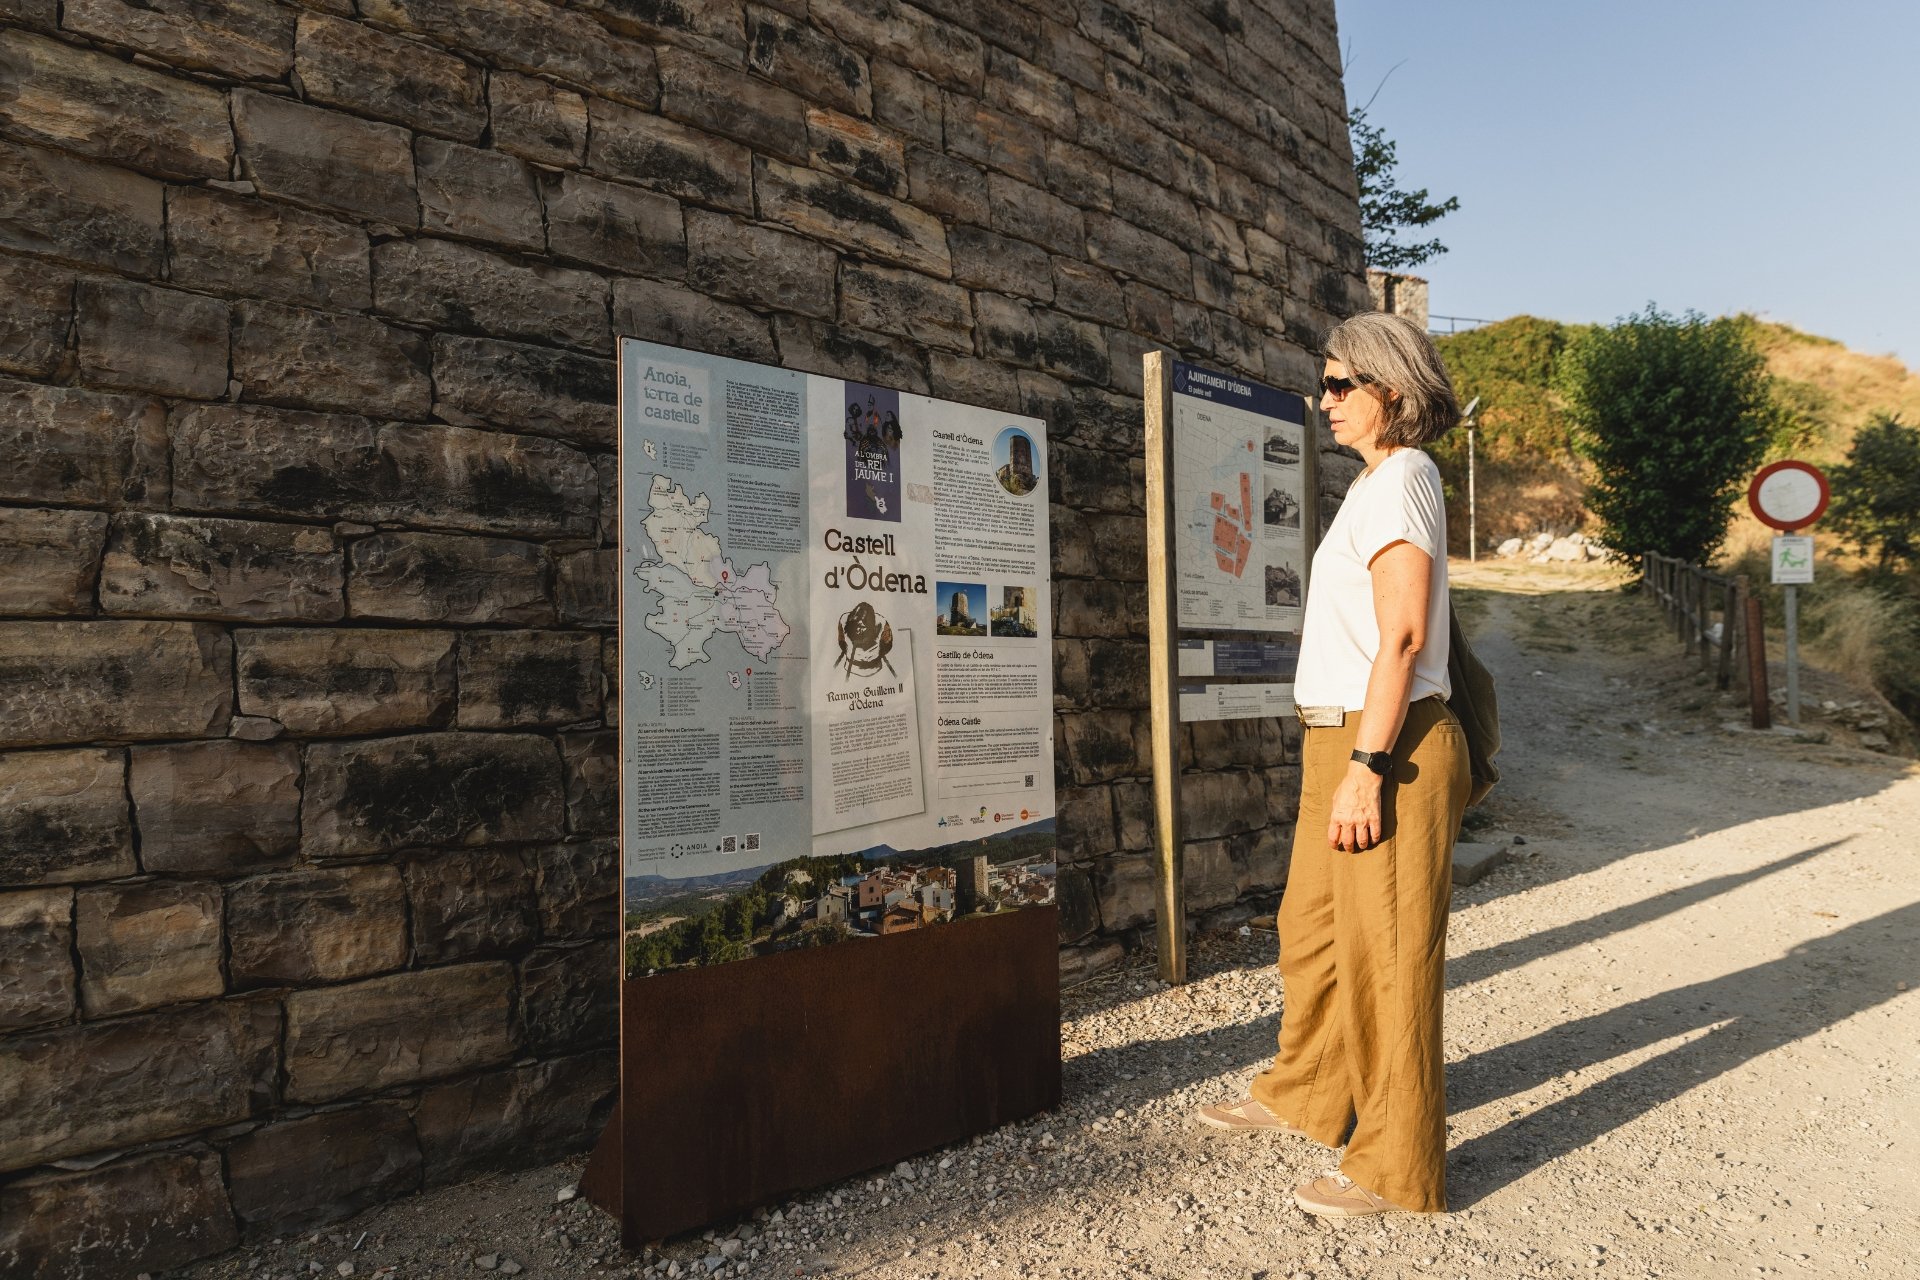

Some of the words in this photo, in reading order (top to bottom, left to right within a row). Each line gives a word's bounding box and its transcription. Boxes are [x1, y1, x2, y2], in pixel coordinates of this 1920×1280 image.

[644, 366, 692, 388] Anoia,
[1188, 370, 1227, 389] AJUNTAMENT
[1228, 380, 1252, 397] D'ÒDENA
[644, 386, 680, 404] terra
[683, 392, 703, 407] de
[1193, 387, 1203, 397] poble
[644, 406, 700, 425] castells
[1197, 412, 1212, 423] ÒDENA
[933, 430, 954, 441] Castell
[956, 433, 983, 446] d'Òdena
[860, 451, 888, 461] L'OMBRA
[867, 460, 882, 471] REI
[855, 469, 887, 482] JAUME
[889, 472, 894, 482] I
[824, 528, 896, 556] Castell
[824, 556, 927, 594] d'Òdena
[937, 650, 961, 659] Castillo
[973, 650, 994, 659] Òdena
[826, 692, 860, 702] Ramon
[864, 686, 895, 697] Guillem
[938, 716, 960, 726] Òdena
[962, 717, 981, 725] Castle
